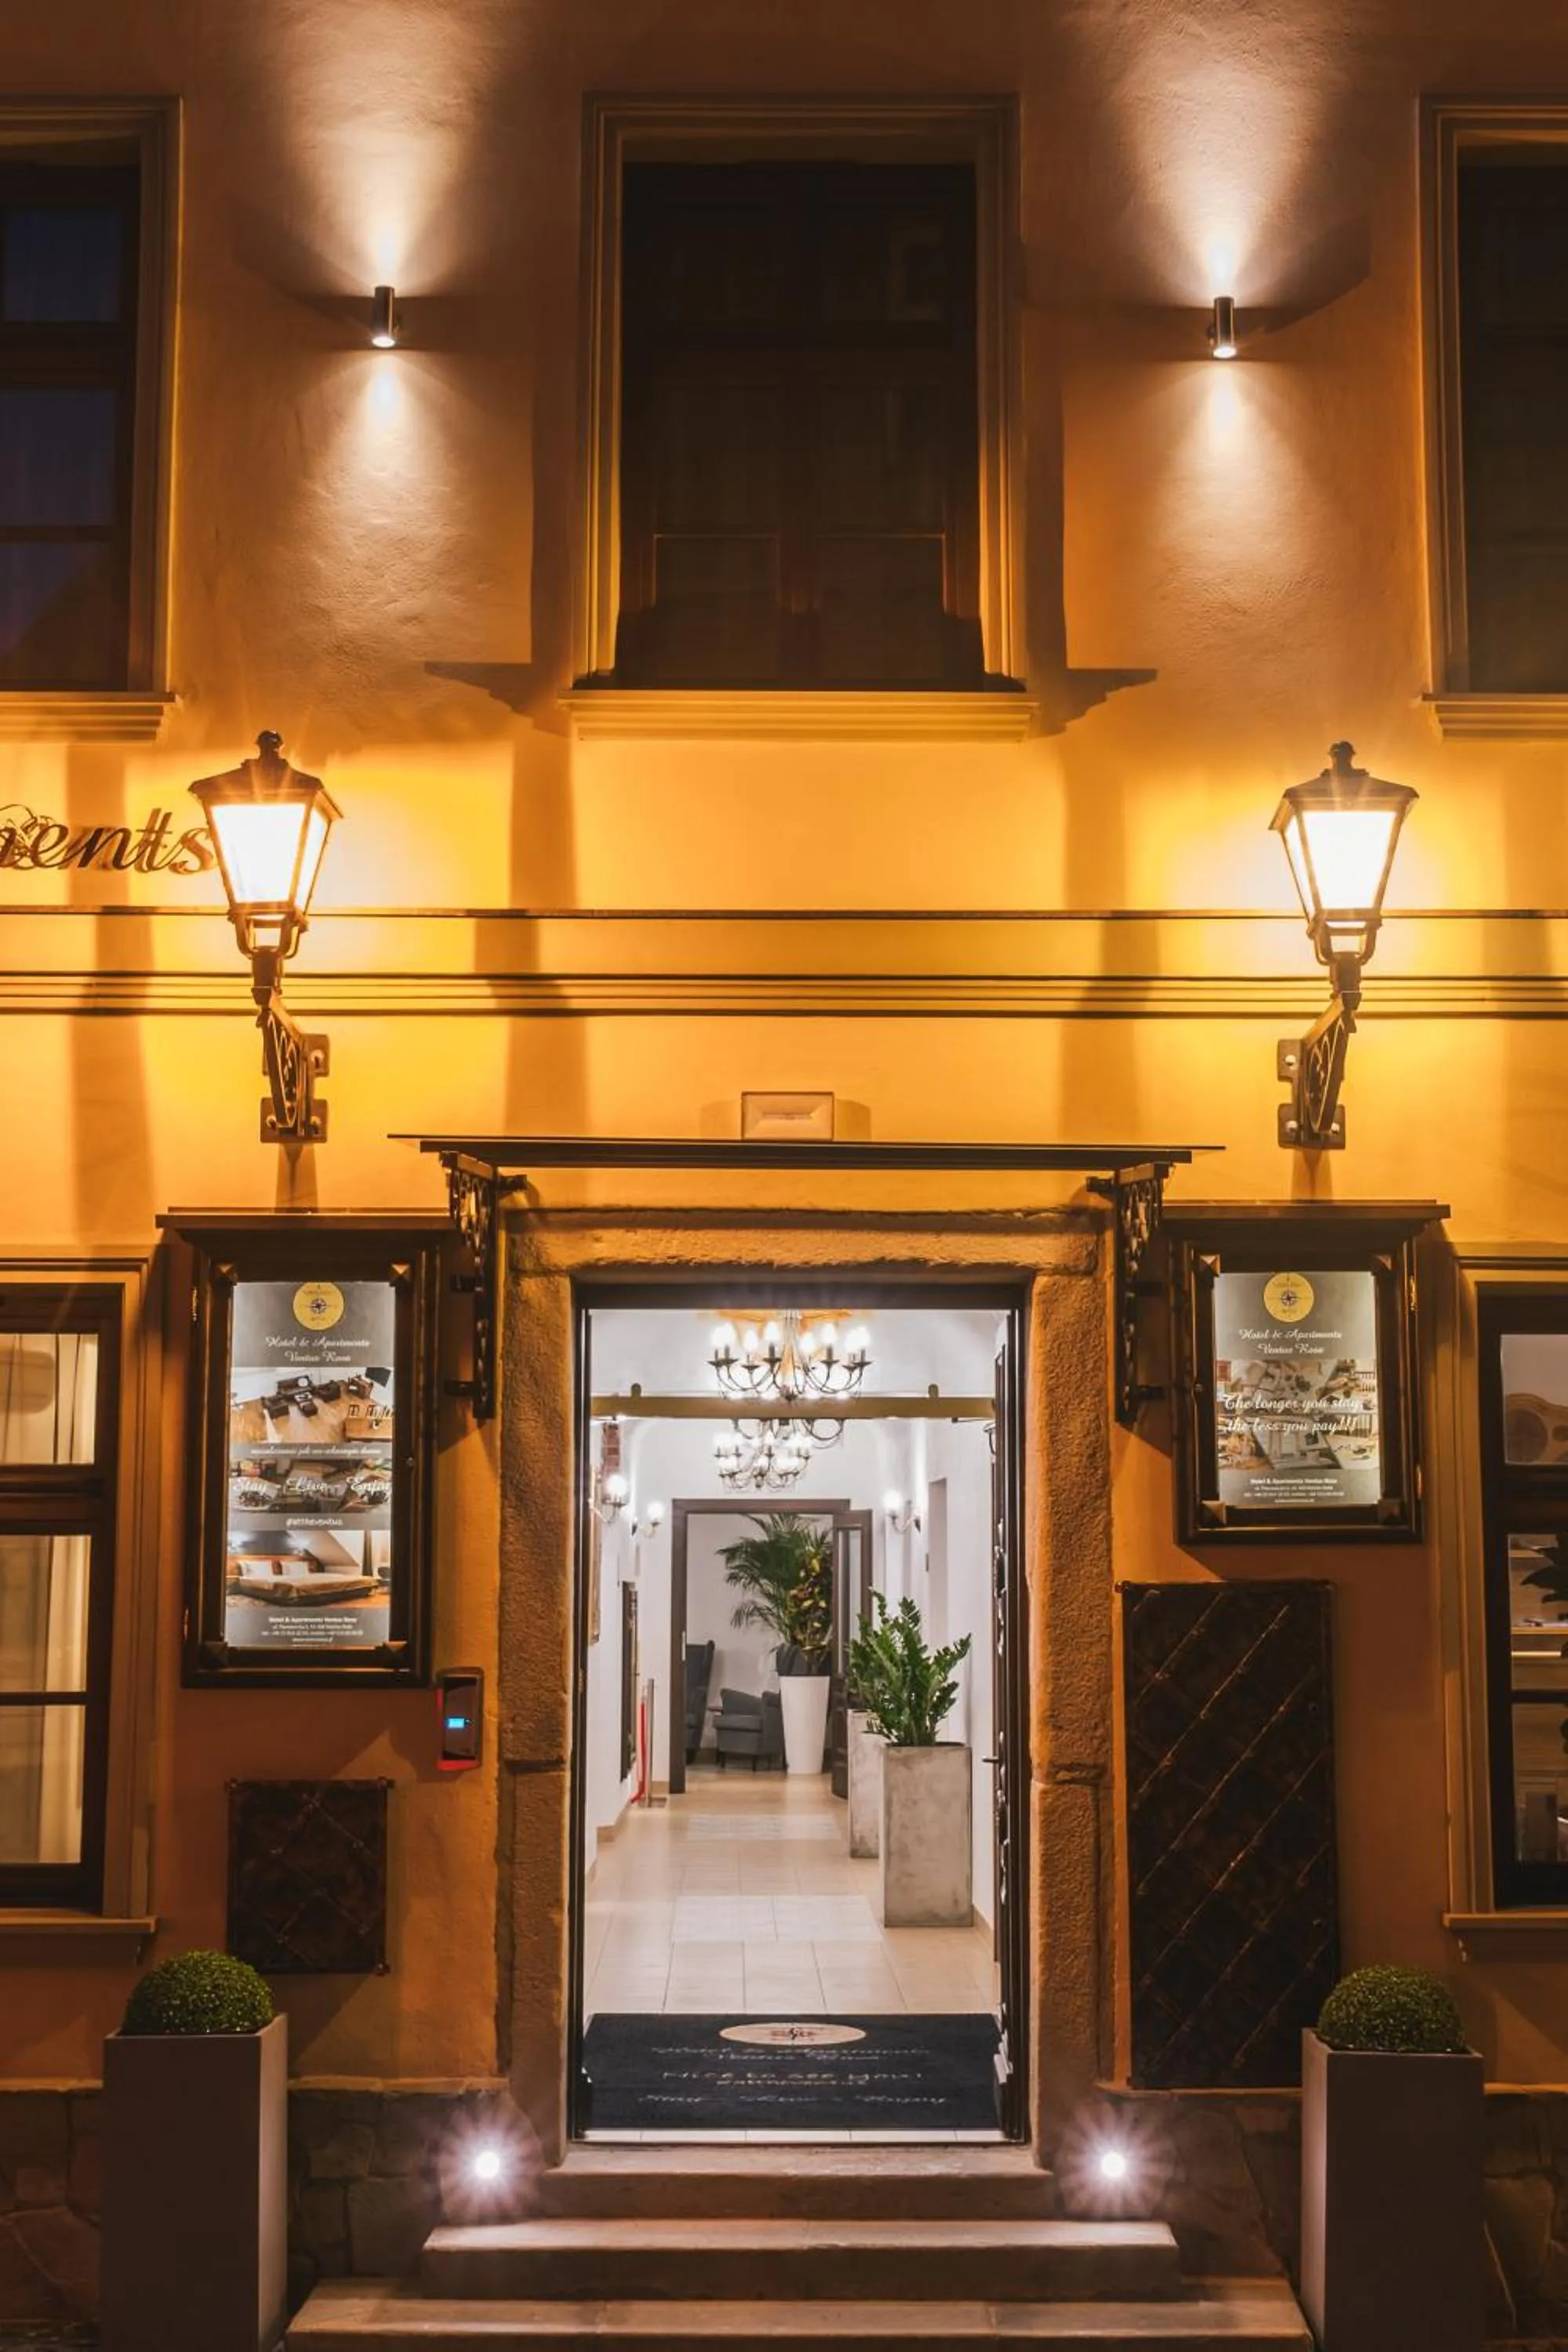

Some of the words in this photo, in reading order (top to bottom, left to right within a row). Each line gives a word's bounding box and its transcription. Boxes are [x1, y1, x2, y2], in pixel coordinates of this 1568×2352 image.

[1239, 1329, 1269, 1339] Hotel
[266, 1336, 296, 1347] Hotel
[1224, 1393, 1254, 1412] The
[1255, 1392, 1298, 1414] longer
[1301, 1398, 1328, 1413] you
[1283, 1421, 1308, 1438] you
